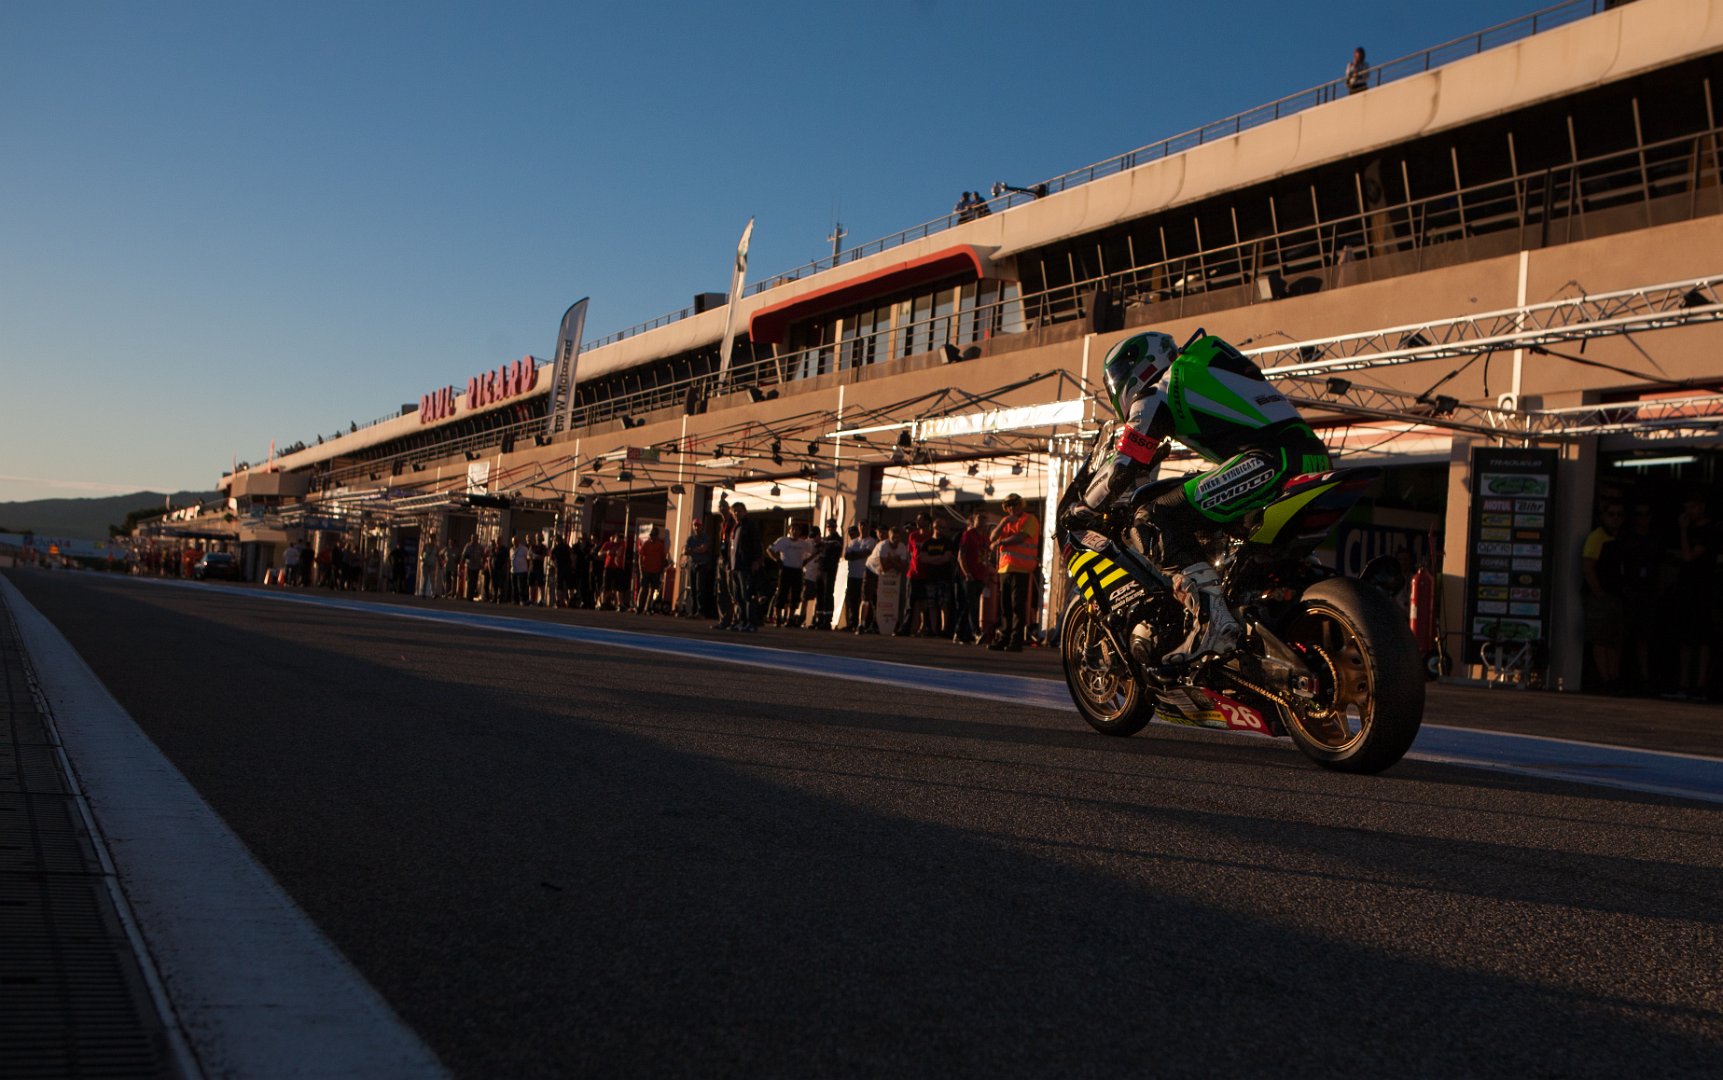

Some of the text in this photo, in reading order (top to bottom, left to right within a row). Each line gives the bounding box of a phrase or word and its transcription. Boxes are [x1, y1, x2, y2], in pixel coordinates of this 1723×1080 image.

[419, 355, 535, 424] PAUL RICARD
[555, 340, 572, 432] BMW Motorrad
[1128, 431, 1156, 450] ISSO
[1221, 703, 1262, 728] 26
